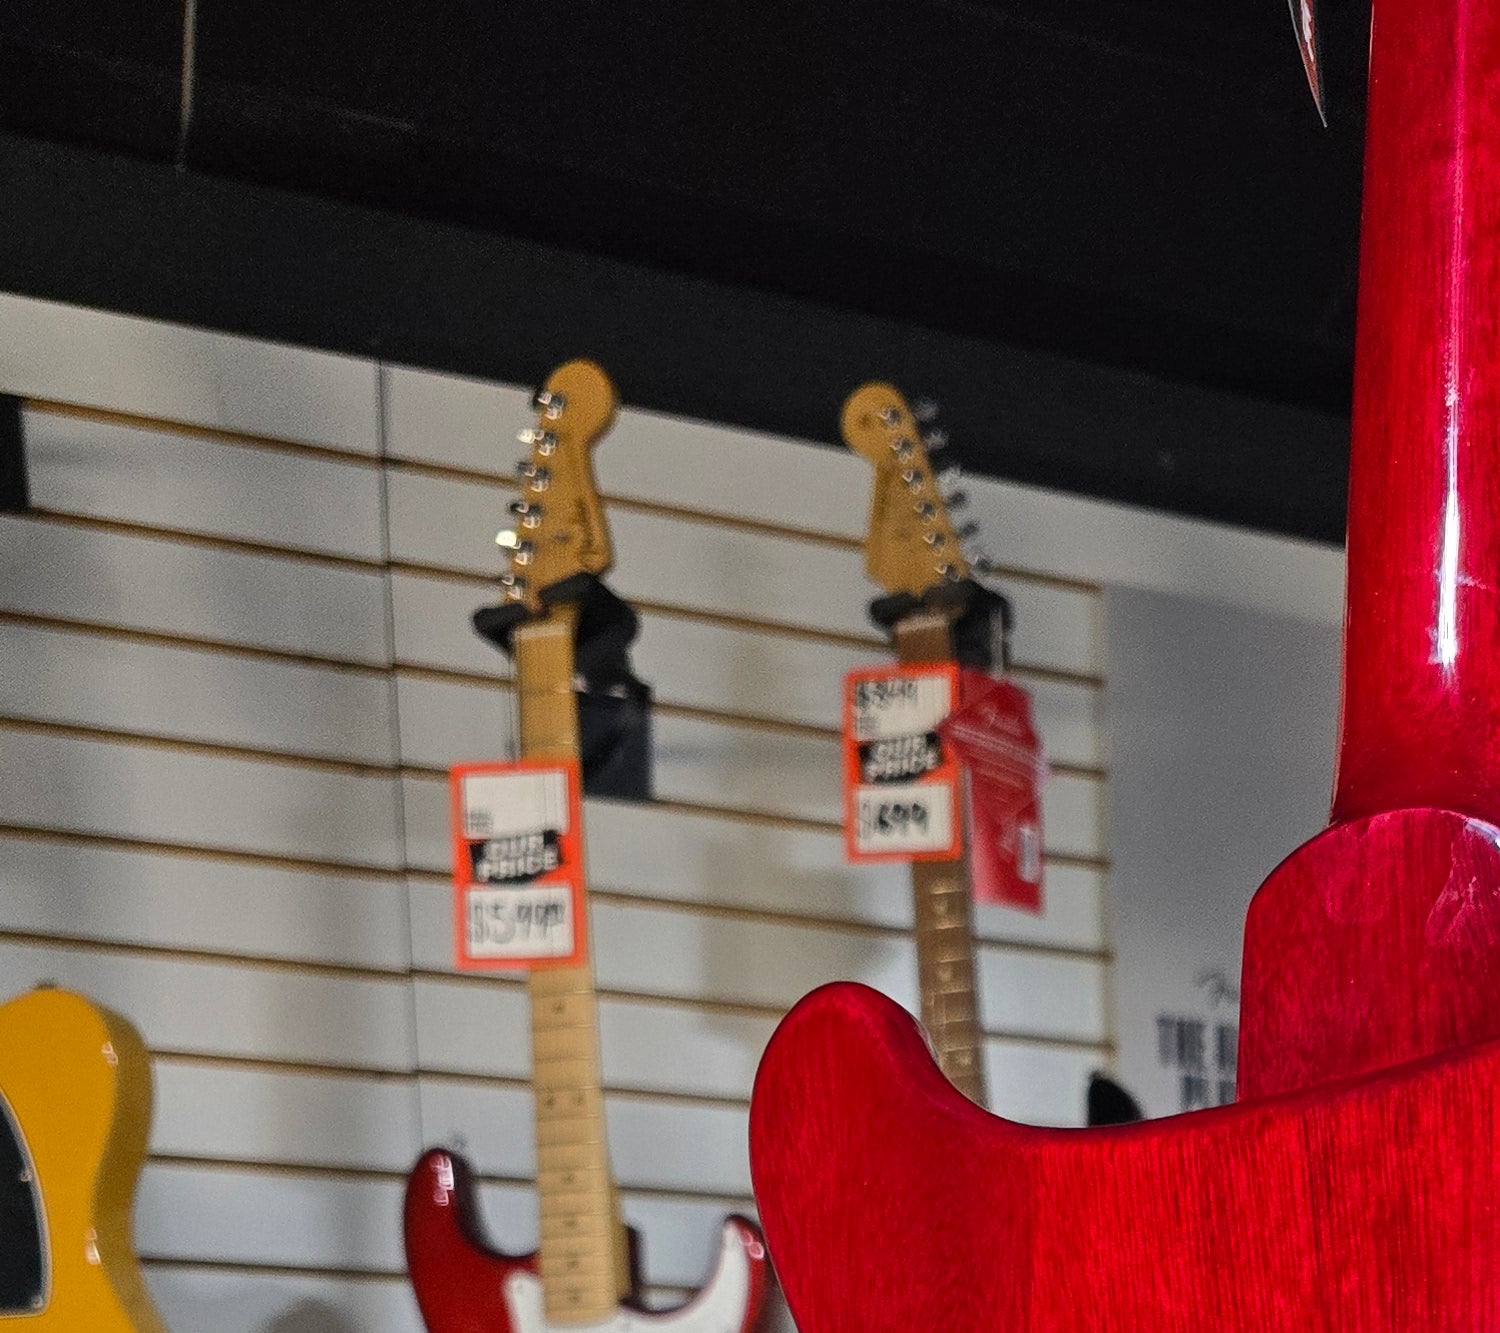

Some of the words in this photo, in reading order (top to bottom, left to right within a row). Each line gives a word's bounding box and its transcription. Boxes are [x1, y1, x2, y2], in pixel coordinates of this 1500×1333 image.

[866, 746, 943, 781] PRICE
[483, 833, 546, 860] OUR
[476, 850, 561, 884] PRICE
